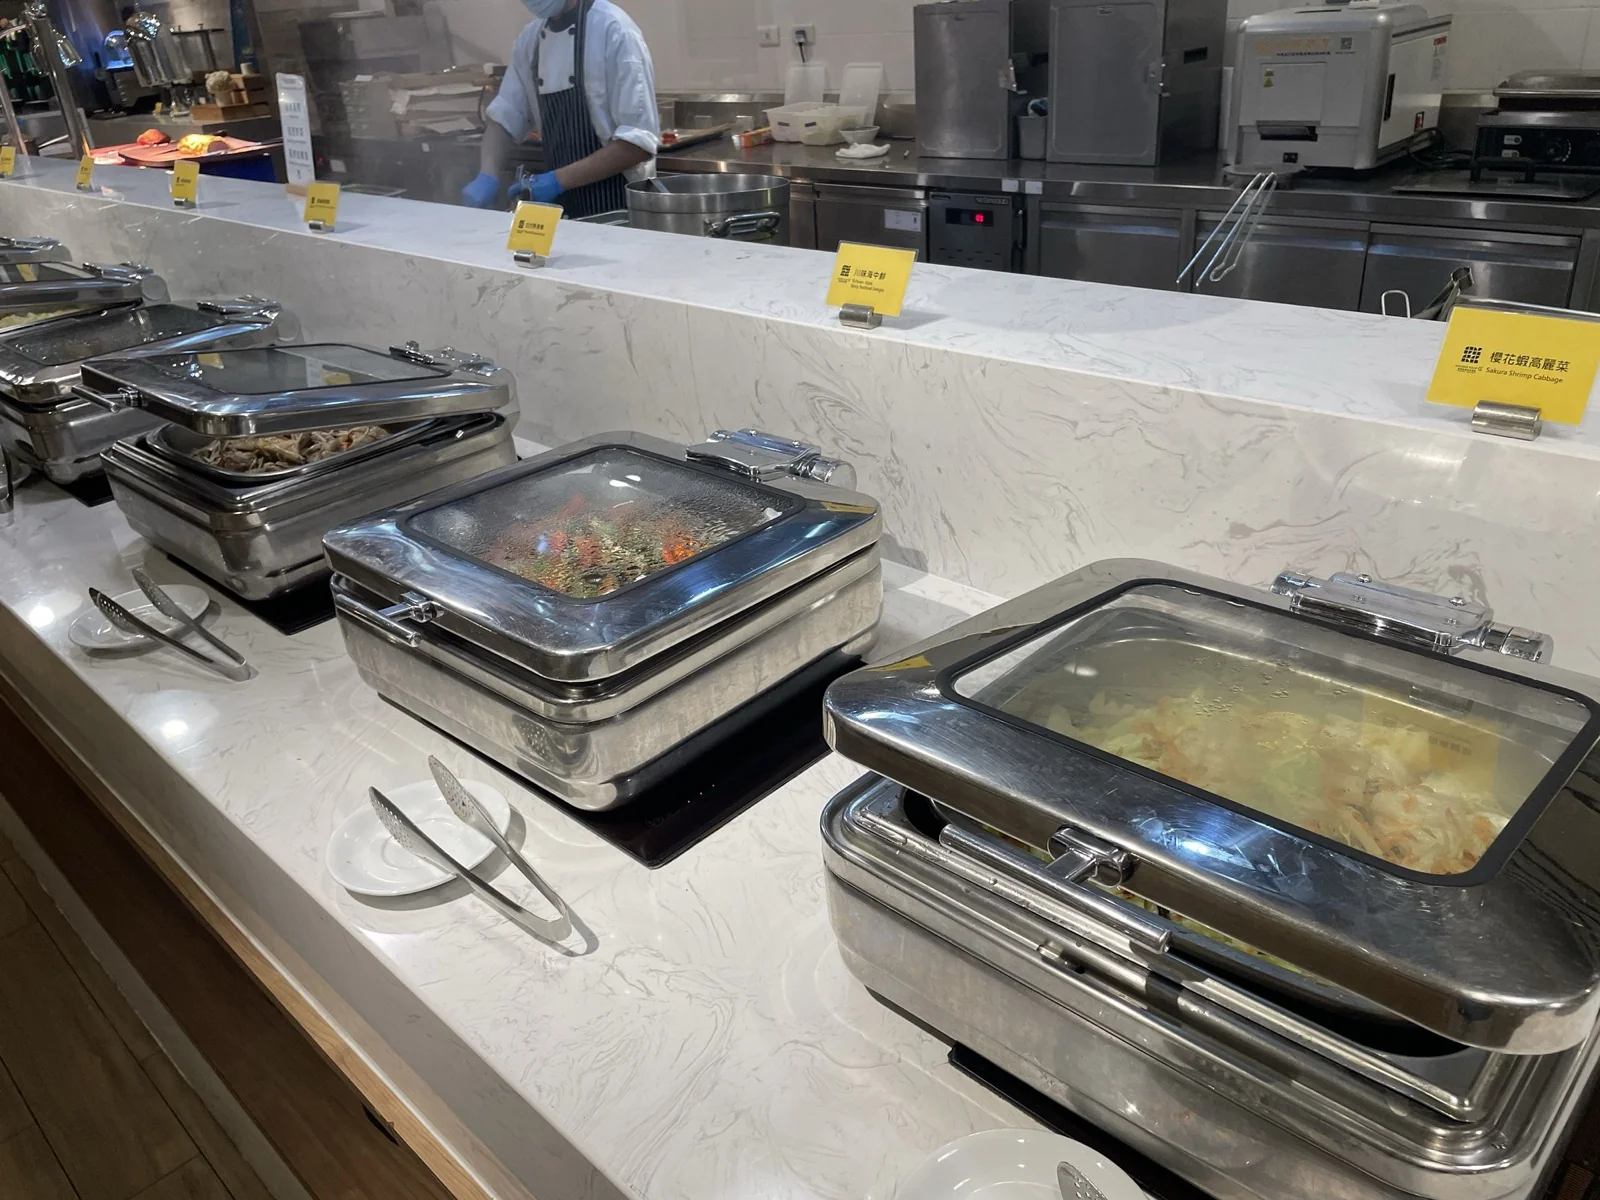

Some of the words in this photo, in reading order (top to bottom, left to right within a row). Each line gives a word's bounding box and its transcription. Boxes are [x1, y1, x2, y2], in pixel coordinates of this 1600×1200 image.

[1490, 351, 1570, 373] 櫻花蝦高麗菜
[1485, 366, 1508, 376] Sakura
[1509, 370, 1532, 380] Shrimp
[1533, 374, 1563, 384] Cabbage
